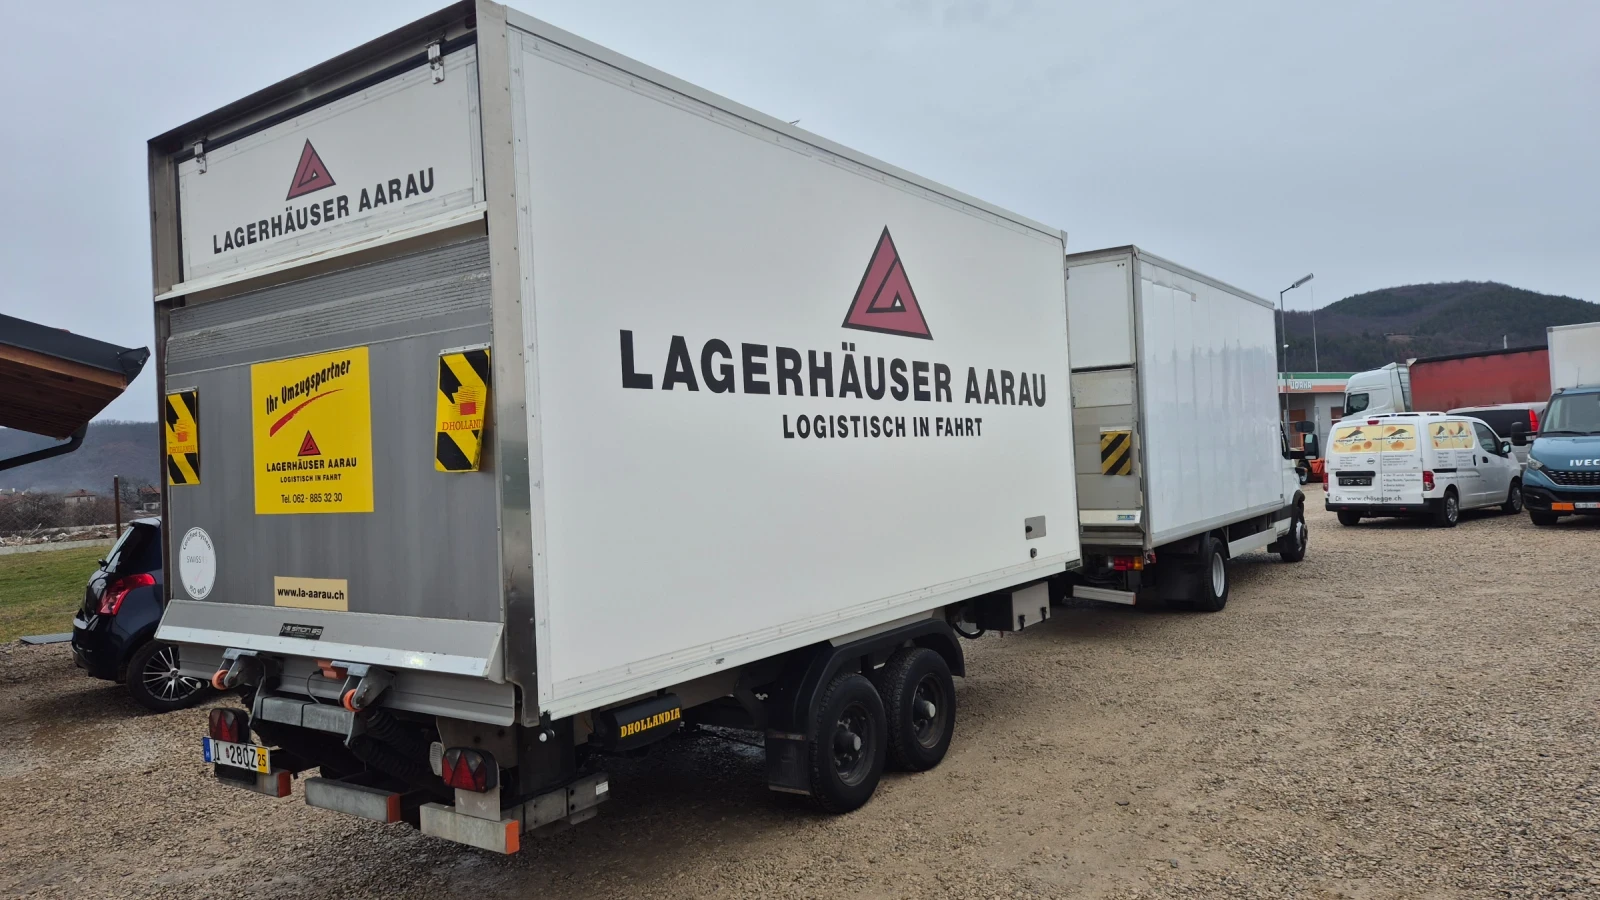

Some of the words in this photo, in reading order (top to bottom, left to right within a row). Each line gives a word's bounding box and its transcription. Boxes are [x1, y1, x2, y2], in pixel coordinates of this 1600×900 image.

[213, 194, 350, 255] LAGERHÄUSER
[358, 167, 435, 212] AARAU
[619, 329, 953, 403] LAGERHÄUSER
[965, 366, 1047, 407] AARAU
[266, 394, 279, 415] Ihr
[281, 359, 351, 404] Umzugspartner
[782, 414, 907, 439] LOGISTISCH
[913, 416, 930, 438] IN
[935, 417, 983, 438] FAHRT
[266, 459, 325, 472] LAGERHÄUSER
[328, 457, 357, 469] AARAU
[280, 475, 314, 483] LOGISTISCH
[322, 473, 342, 481] FAHRT
[281, 494, 292, 504] Tel.
[292, 494, 305, 504] 062
[309, 493, 323, 503] 885
[323, 493, 333, 503] 32
[333, 492, 343, 503] 30
[277, 586, 345, 601] www.la-aarau.ch
[620, 707, 681, 738] DHOLLANDIA
[257, 753, 267, 767] 25
